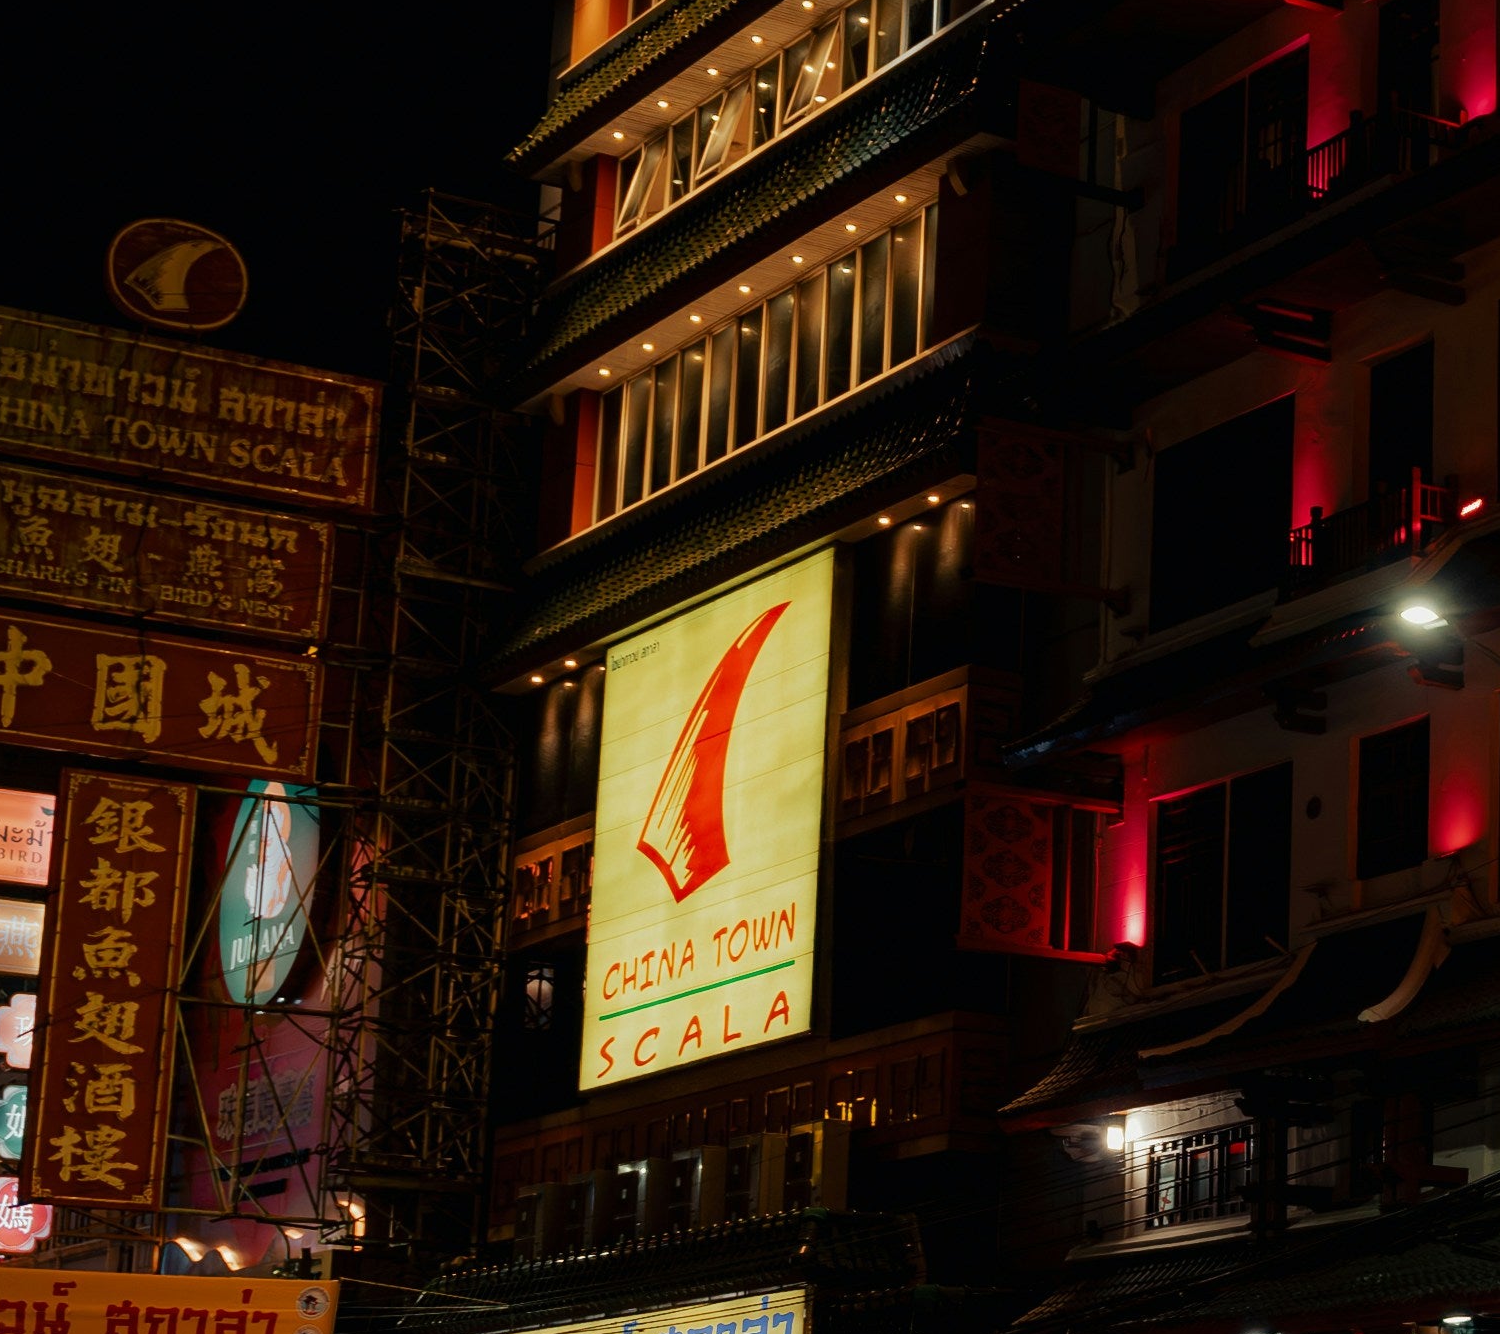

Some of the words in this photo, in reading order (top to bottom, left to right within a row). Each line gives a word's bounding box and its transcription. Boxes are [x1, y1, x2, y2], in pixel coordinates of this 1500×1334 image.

[104, 413, 220, 466] TOWN
[228, 437, 350, 487] SCALA
[96, 569, 133, 596] FIN
[159, 582, 234, 611] BIRD'S
[238, 596, 295, 622] NEST
[230, 922, 296, 971] JUAMA
[602, 938, 696, 1002] CHINA
[712, 901, 797, 964] TOWN
[47, 793, 166, 1190] 銀都魚翅酒樓
[597, 989, 791, 1080] SCALA
